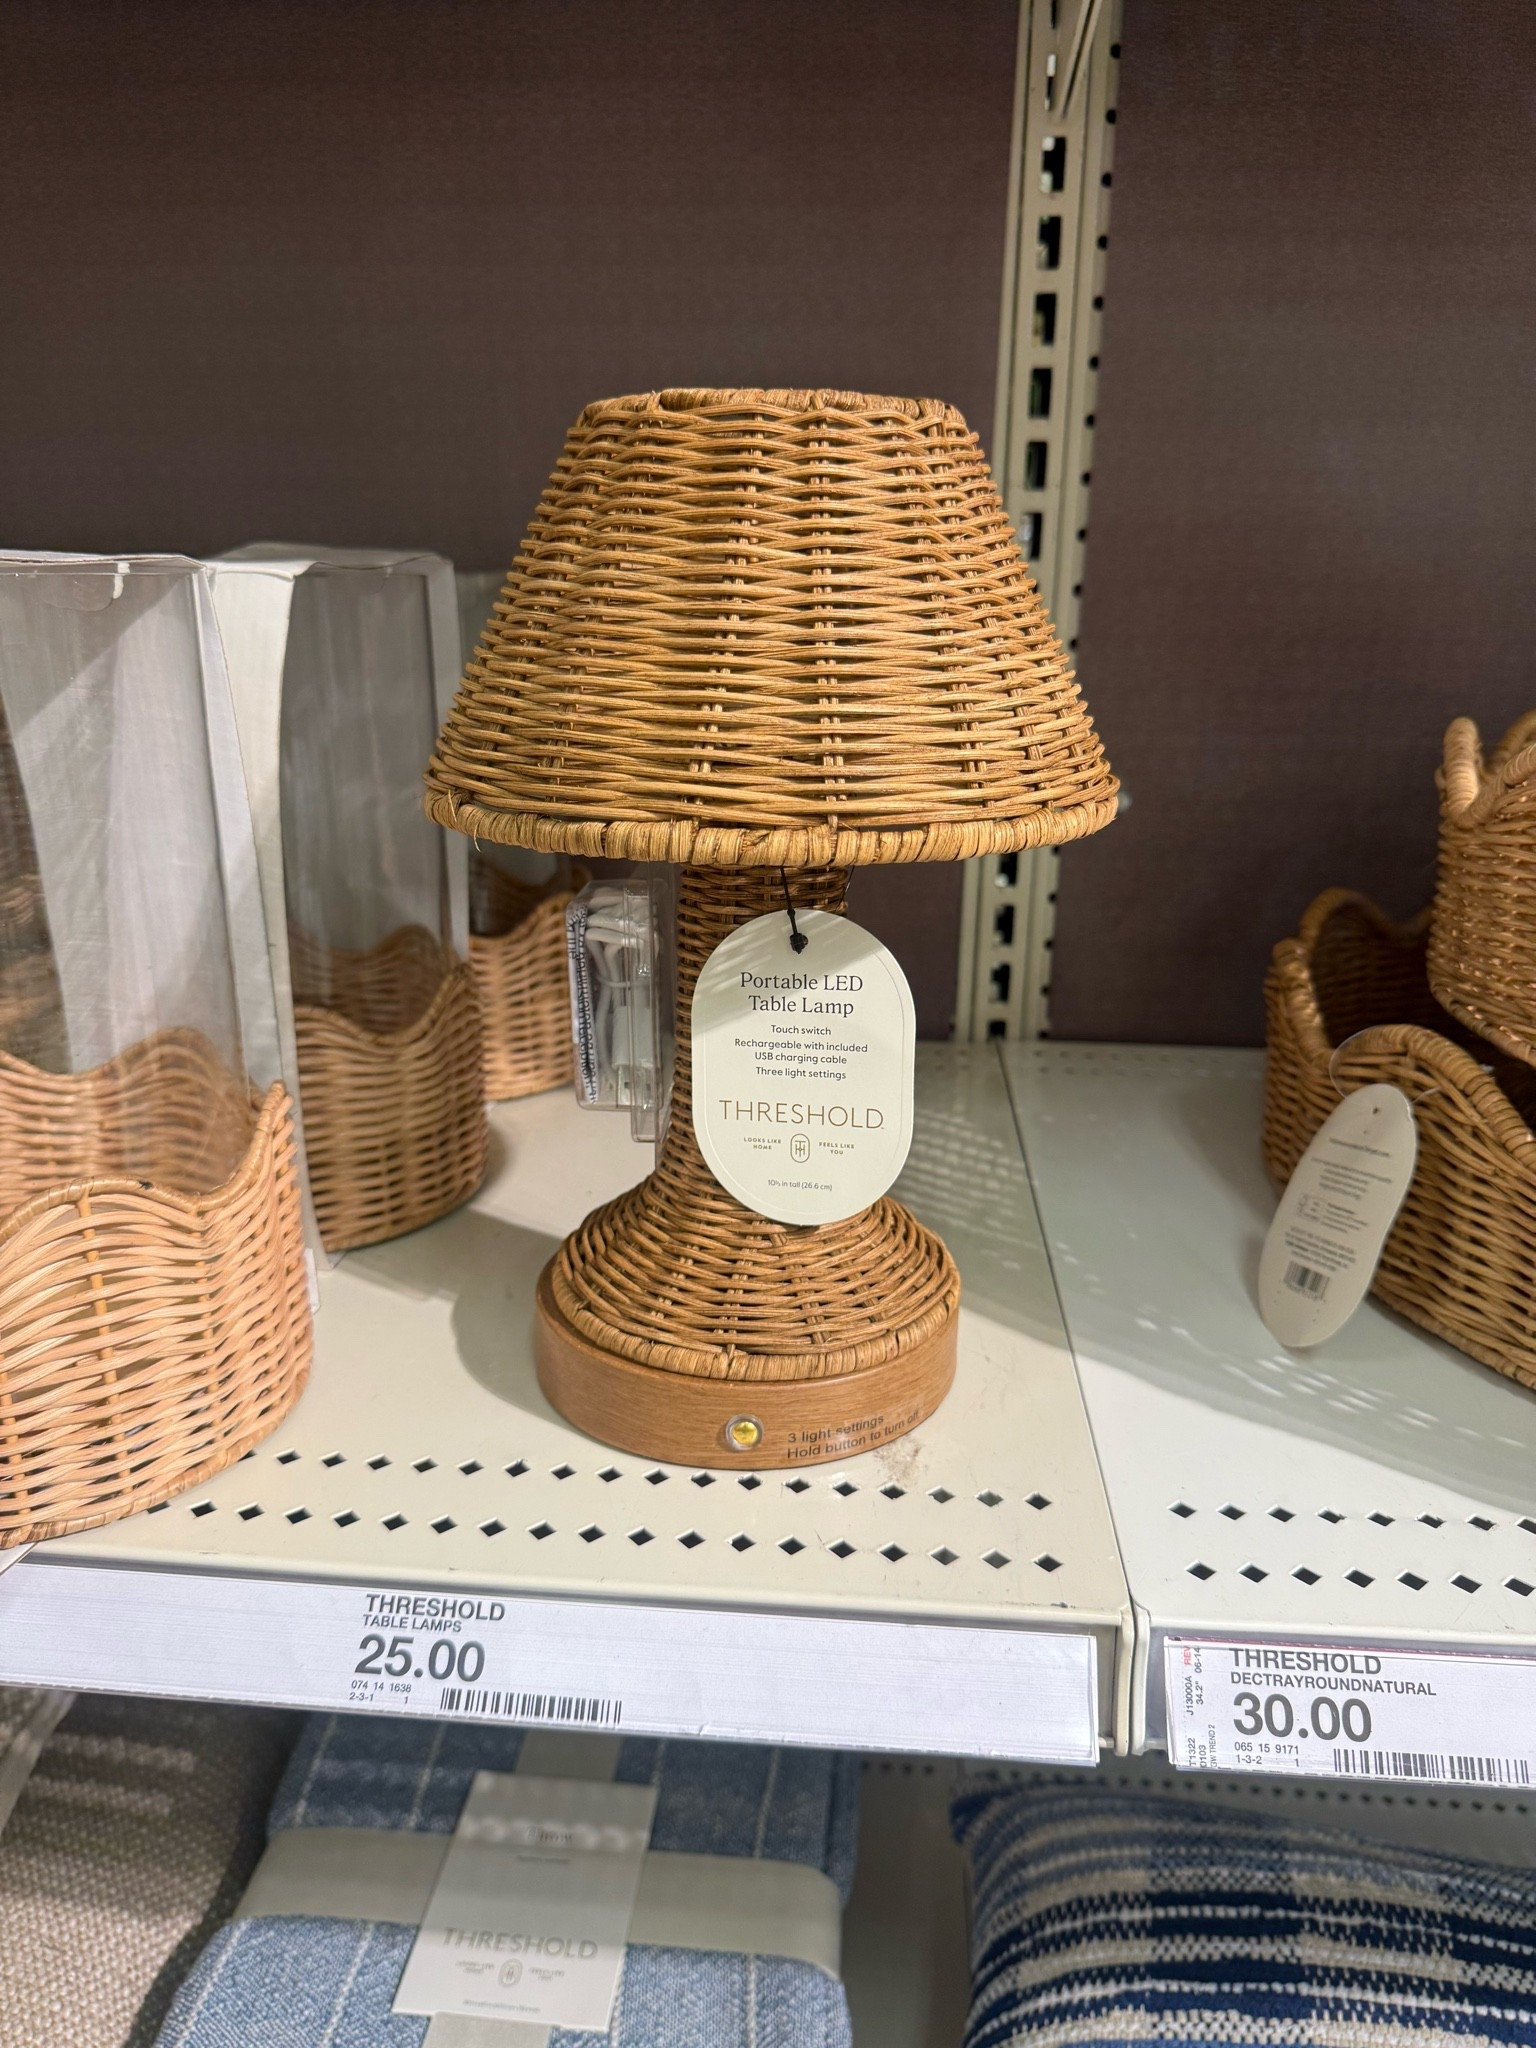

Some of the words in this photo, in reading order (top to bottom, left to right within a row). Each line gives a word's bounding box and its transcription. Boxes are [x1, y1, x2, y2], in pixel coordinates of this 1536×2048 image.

[741, 971, 818, 990] Portable
[823, 974, 863, 991] LED
[748, 994, 797, 1012] Table
[802, 997, 854, 1018] Lamp
[770, 1024, 799, 1034] Touch
[801, 1026, 832, 1035] switch
[734, 1038, 802, 1050] Rechargeable
[803, 1041, 825, 1050] with
[826, 1042, 868, 1053] included
[754, 1051, 774, 1061] USB
[775, 1053, 819, 1064] charging
[820, 1055, 847, 1064] cable
[755, 1066, 783, 1076] Three
[785, 1067, 807, 1078] light
[808, 1069, 847, 1081] settings
[718, 1099, 884, 1129] THRESHOLD
[743, 1136, 766, 1144] LOOKS
[818, 1141, 839, 1149] FEELS
[801, 1181, 819, 1190] (26.6
[820, 1183, 833, 1192] cm)
[787, 1433, 797, 1443] 3
[801, 1428, 832, 1443] light
[833, 1414, 885, 1435] settings
[787, 1445, 821, 1459] Hold
[825, 1436, 866, 1454] button
[870, 1430, 881, 1441] to
[884, 1420, 905, 1436] turn
[366, 1593, 505, 1621] THRESHOLD
[363, 1614, 408, 1629] TABLE
[411, 1617, 462, 1633] LAMPS
[354, 1633, 486, 1683] 25.00
[1229, 1648, 1382, 1675] THRESHOLD
[351, 1680, 369, 1690] 074
[374, 1681, 384, 1691] 14
[389, 1683, 412, 1693] 1638
[1231, 1671, 1437, 1696] DECTRAYROUNDNATURAL
[349, 1692, 374, 1702] 2-3-1
[404, 1695, 409, 1704] 1
[1185, 1675, 1194, 1716] J13000A
[1233, 1691, 1372, 1743] 30.00
[1208, 1729, 1216, 1754] TREND
[1234, 1742, 1253, 1752] 065
[1258, 1743, 1271, 1753] 15
[1275, 1744, 1299, 1755] 9171
[1236, 1755, 1263, 1765] 1-3-2
[1294, 1758, 1299, 1768] 1
[442, 1927, 599, 1960] THRESHOLD
